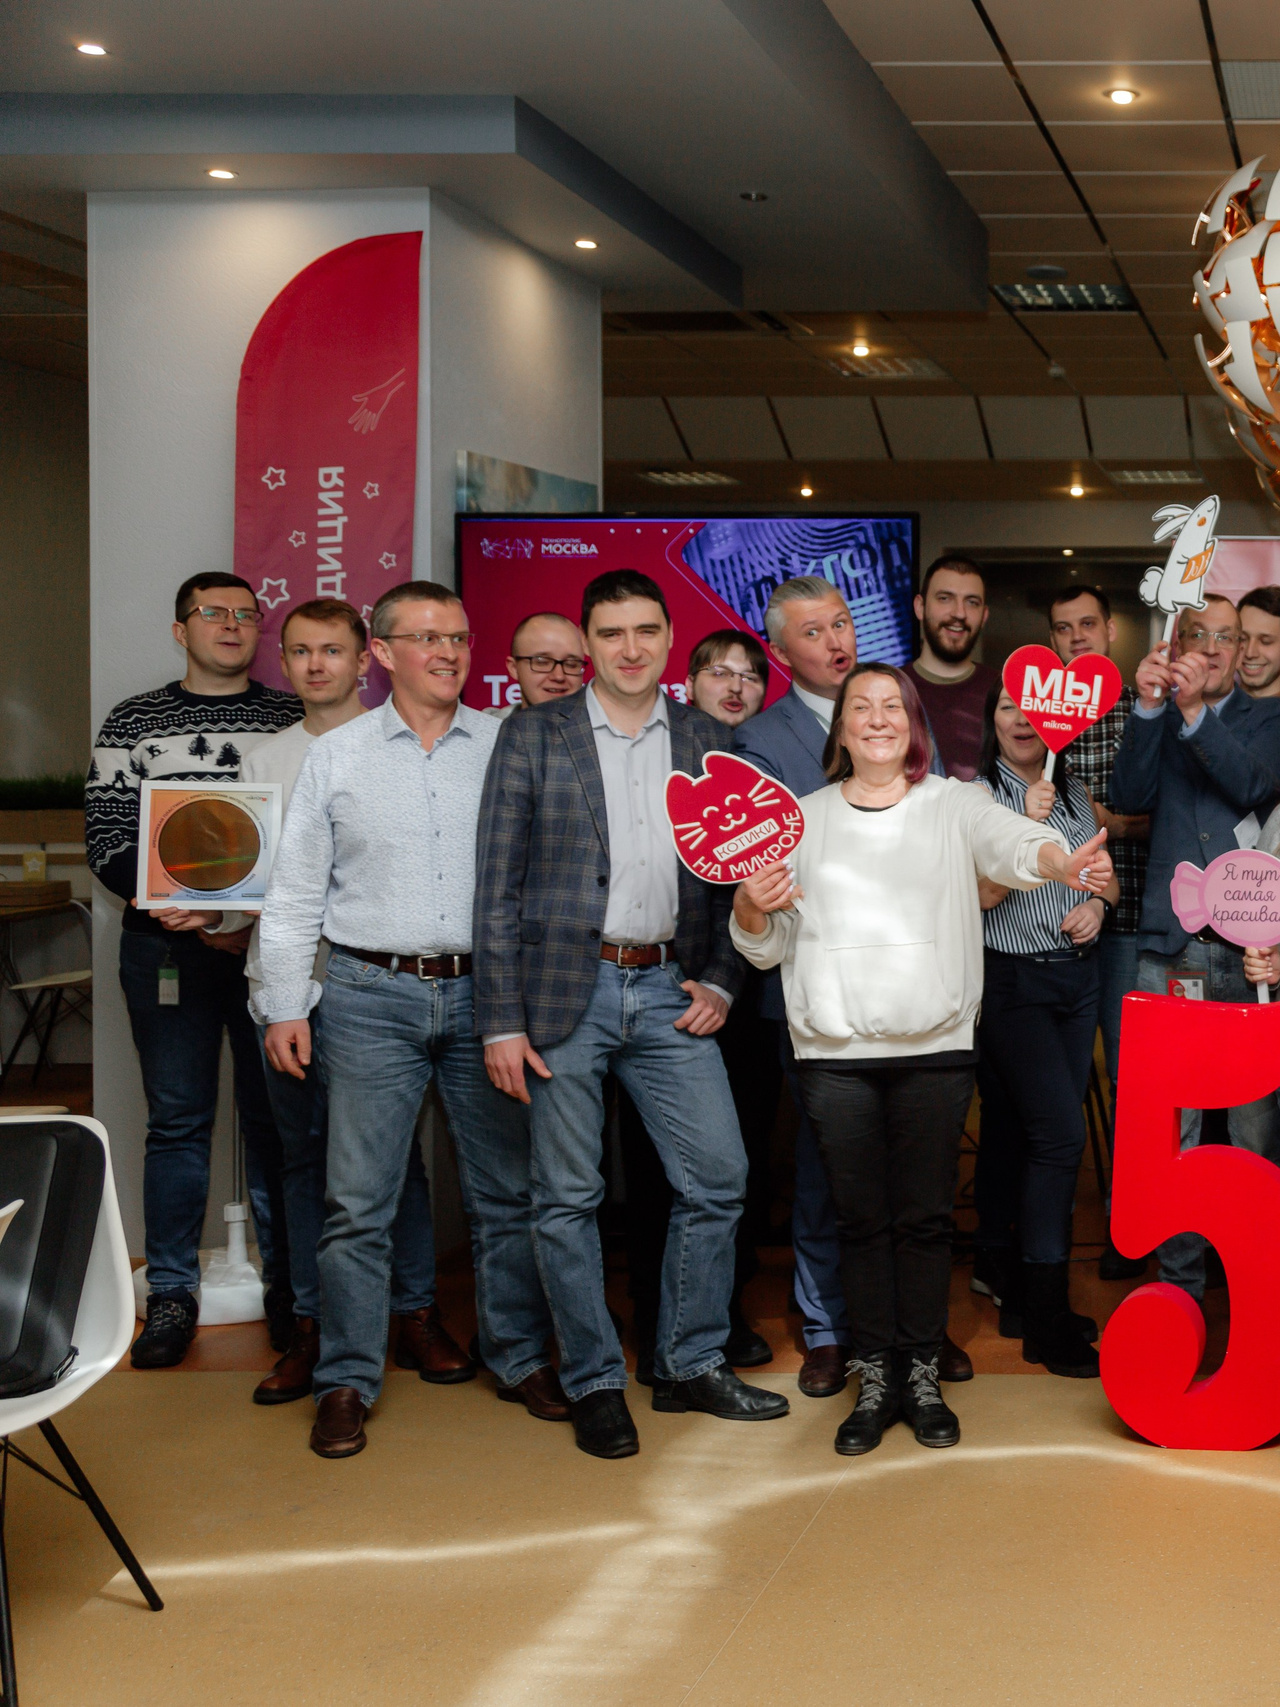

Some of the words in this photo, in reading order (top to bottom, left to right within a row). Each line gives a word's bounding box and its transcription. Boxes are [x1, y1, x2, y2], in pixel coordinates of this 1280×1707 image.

[541, 543, 599, 555] МОСКВА
[1022, 664, 1103, 706] МЫ
[1020, 696, 1099, 719] ВМЕСТЕ
[1042, 719, 1072, 731] mikron
[692, 856, 722, 880] НА
[729, 809, 801, 879] МИКРОНЕ
[716, 821, 777, 859] КОТИКИ
[1222, 862, 1238, 881] Я
[1241, 868, 1280, 887] тут
[1223, 889, 1277, 902] самая
